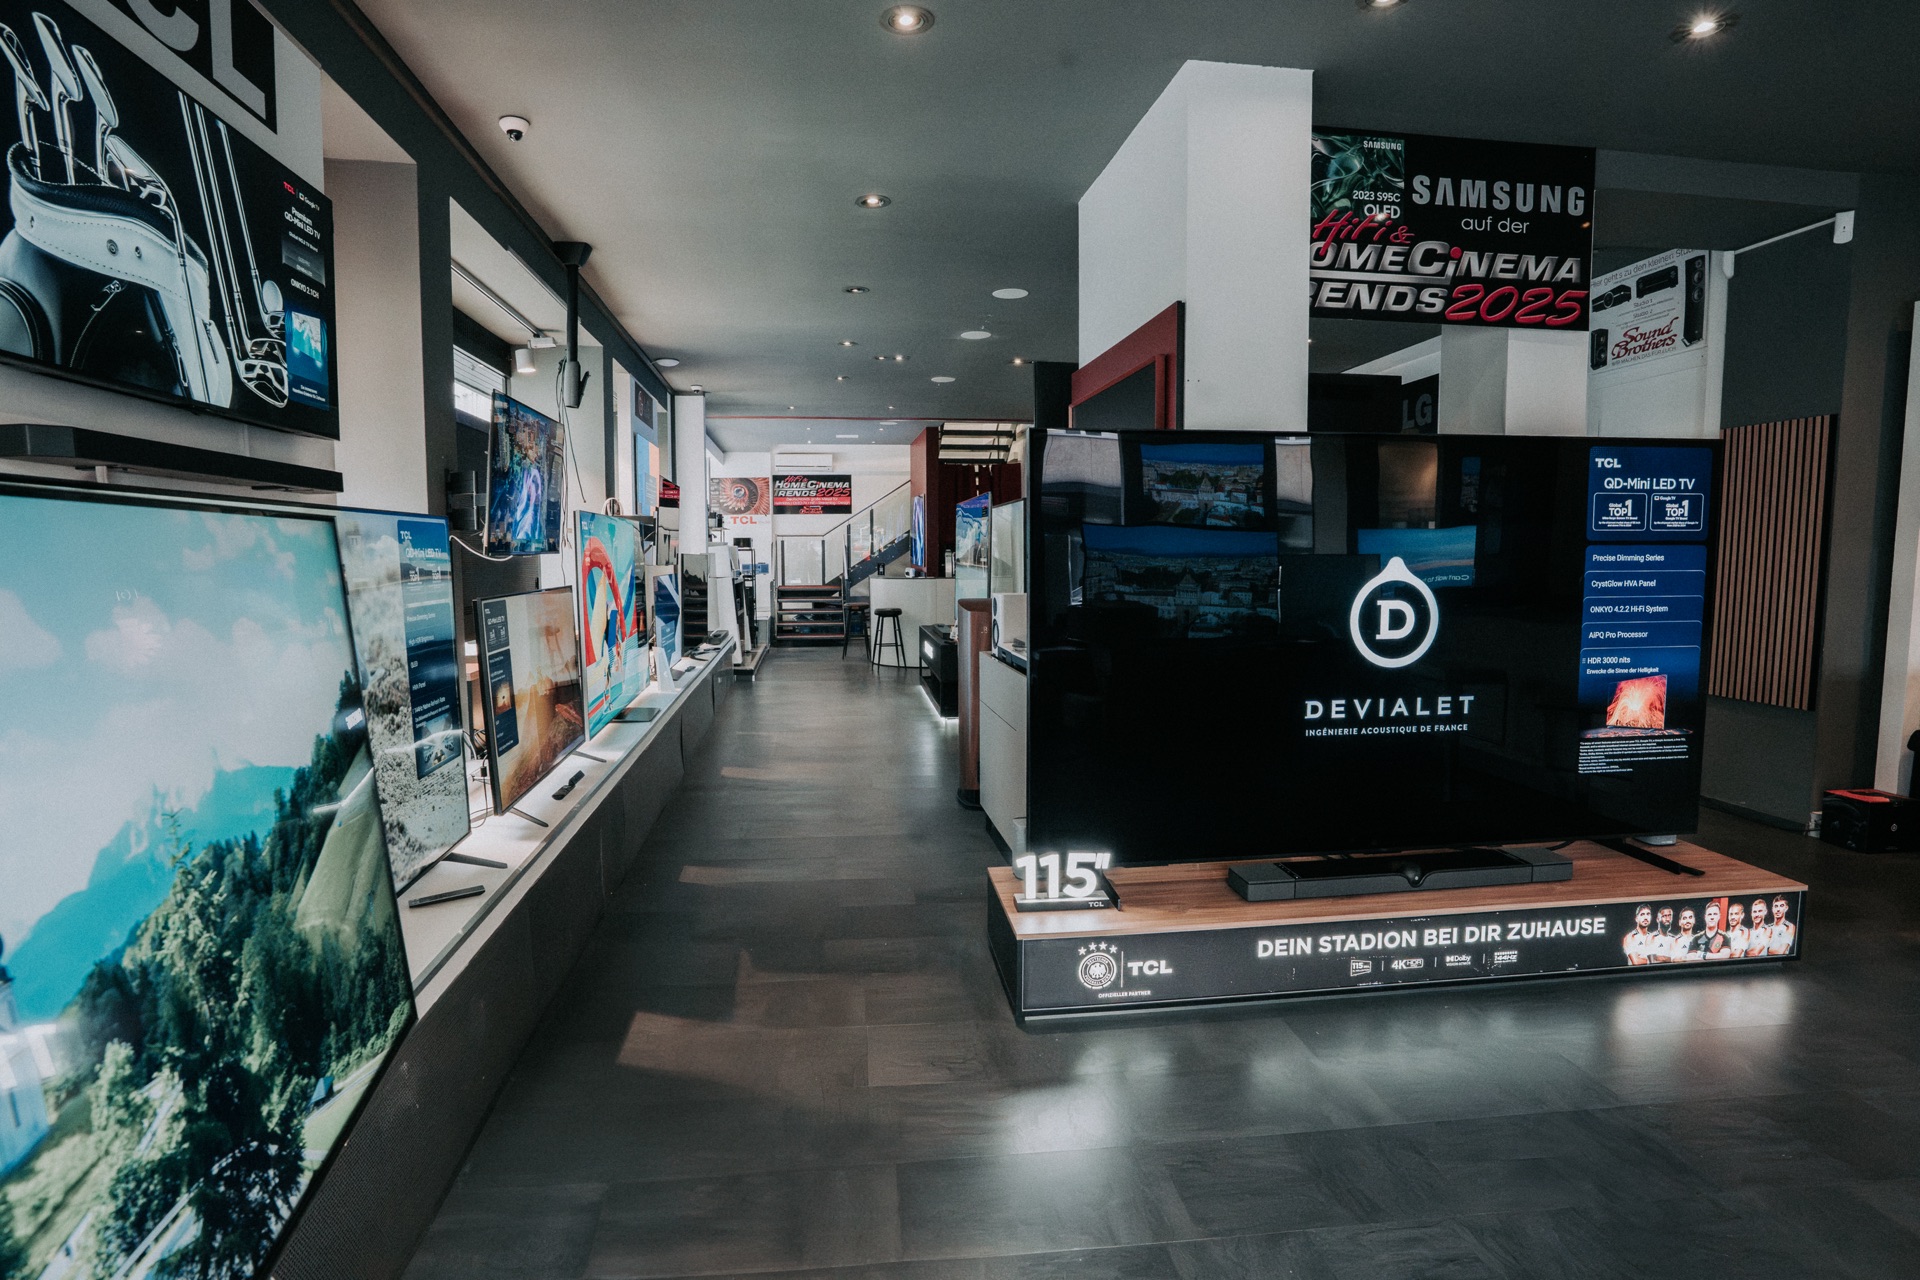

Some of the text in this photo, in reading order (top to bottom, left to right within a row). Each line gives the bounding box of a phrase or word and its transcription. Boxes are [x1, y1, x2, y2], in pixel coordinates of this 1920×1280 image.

[1363, 140, 1401, 151] SAMSUNG
[283, 181, 295, 195] TCL
[1352, 190, 1401, 202] 2023 S95C
[1412, 174, 1585, 216] SAMSUNG
[291, 206, 313, 226] Premium
[284, 211, 321, 240] QD-Mini LED TV
[1461, 216, 1530, 234] auf der
[1312, 209, 1415, 256] HiFi &
[1633, 263, 1647, 274] den
[1647, 255, 1674, 268] kleinen
[290, 278, 320, 299] ONKYO 2.1CH
[1309, 280, 1449, 314] ENDS
[1445, 283, 1589, 326] 2025
[1633, 299, 1650, 309] Studio
[1633, 310, 1649, 319] Studio
[1623, 316, 1680, 343] Sound
[1612, 334, 1678, 360] Brothers
[1621, 356, 1641, 364] MACHEN
[1402, 393, 1433, 430] LG
[1595, 458, 1622, 468] TCL
[784, 475, 802, 484] HiFi
[1604, 477, 1695, 490] QD-Mini LED TV
[774, 488, 851, 497] TRENDS 2025
[730, 516, 757, 525] TCL
[400, 531, 412, 540] TCL
[425, 548, 434, 558] LED
[1592, 554, 1665, 563] Precise Dimming Series
[1591, 580, 1623, 589] CrystGlow
[1645, 605, 1668, 614] System
[1375, 599, 1415, 640] D
[1619, 656, 1631, 664] nits
[1304, 695, 1475, 720] DEVIALET
[1305, 727, 1358, 737] INGÉNIERIE
[1361, 725, 1417, 735] ACOUSTIQUE
[1434, 724, 1468, 732] FRANCE
[1016, 852, 1111, 899] 115"
[1257, 917, 1606, 958] DEIN STADION BEI DIR ZUHAUSE
[1127, 960, 1173, 976] TCL
[1391, 960, 1406, 969] 4K
[1098, 991, 1128, 999] OFFIZIELLER
